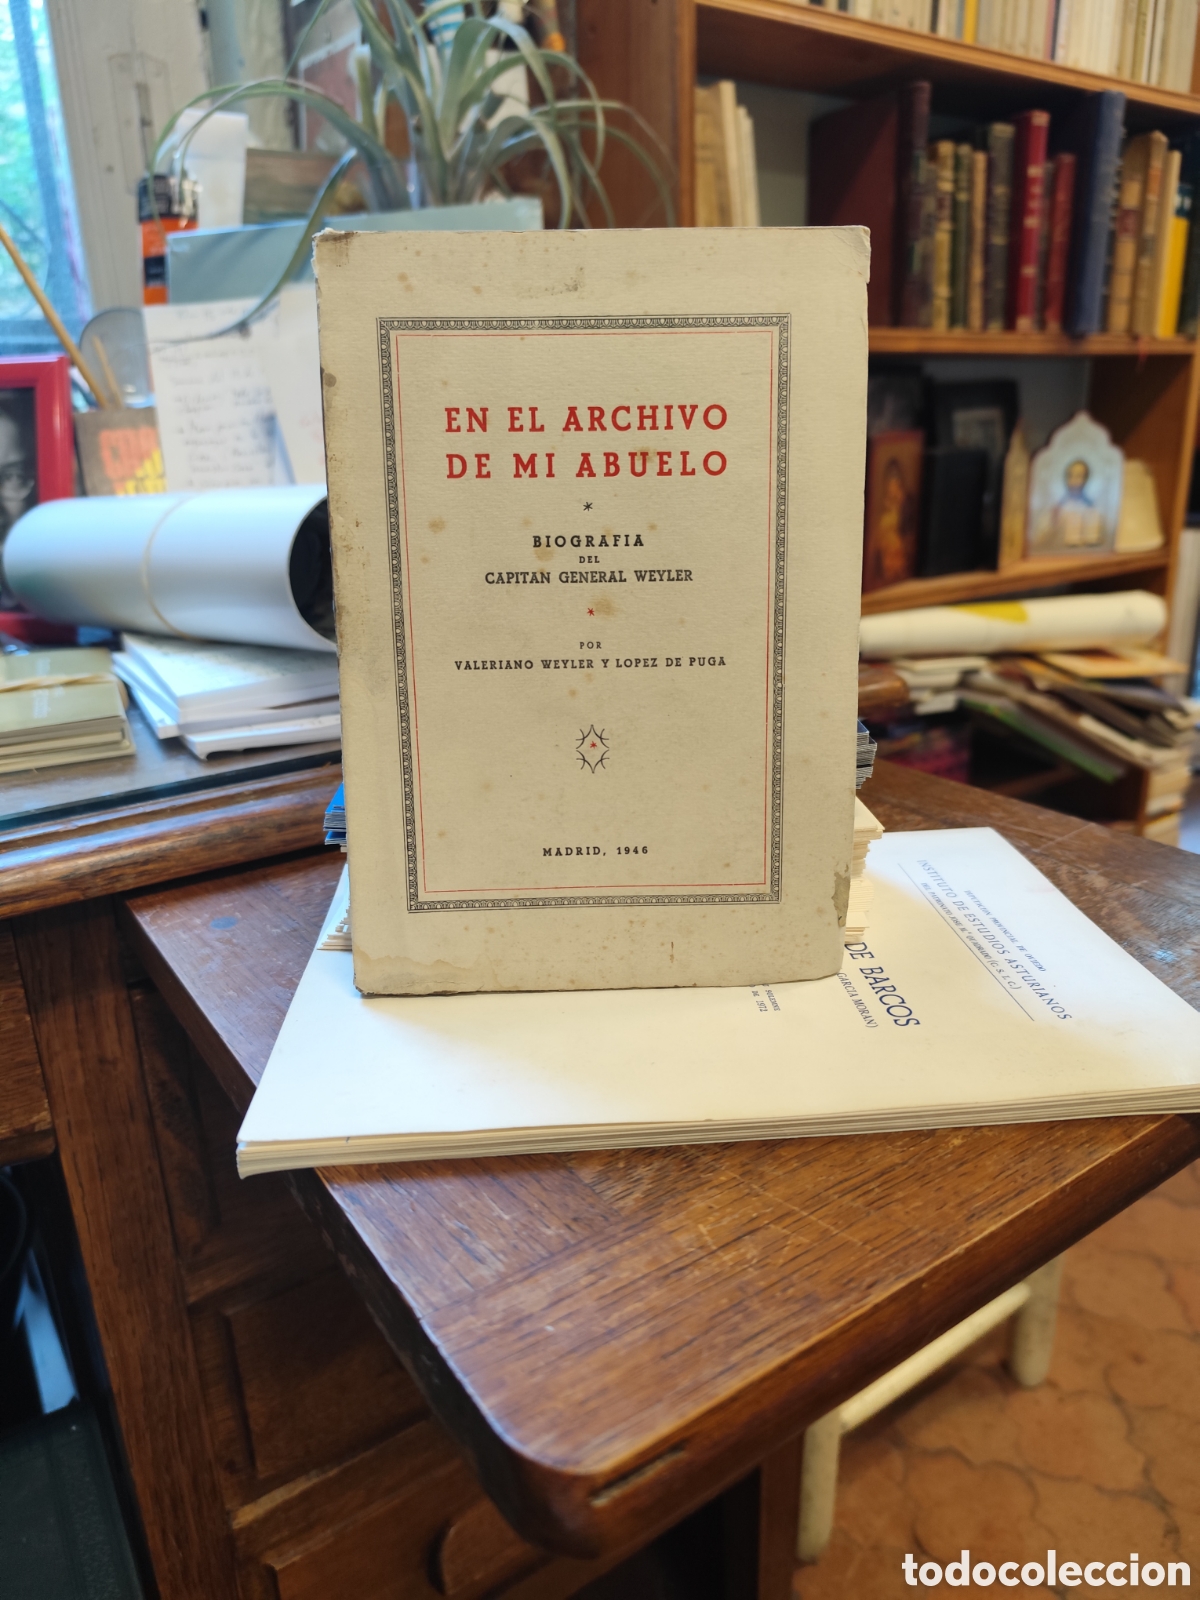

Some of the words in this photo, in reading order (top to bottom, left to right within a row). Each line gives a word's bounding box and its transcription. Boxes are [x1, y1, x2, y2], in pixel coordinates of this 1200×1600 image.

[445, 407, 489, 433] EN
[507, 406, 545, 432] EL
[562, 404, 728, 432] ARCHIVO
[446, 453, 491, 479] DE
[513, 453, 556, 478] MI
[575, 451, 728, 478] ABUELO
[532, 534, 645, 549] BIOGRAFIA
[578, 556, 601, 565] DEL
[485, 571, 551, 585] CAPITAN
[559, 571, 627, 584] GENERAL
[634, 570, 694, 583] WEYLER
[579, 642, 603, 651] POR
[455, 660, 535, 672] VALERIANO
[541, 660, 595, 670] WEYLER
[602, 659, 610, 669] Y
[616, 659, 659, 669] LOPEZ
[666, 658, 682, 668] DE
[689, 657, 727, 668] PUGA
[542, 846, 607, 857] MADRID,
[616, 845, 649, 855] 1946
[917, 859, 958, 898] INSTITUTO
[951, 900, 970, 911] DE
[963, 913, 1010, 955] ESTUDIOS
[1004, 958, 1073, 1020] ASTURIANOS
[844, 941, 875, 960] DE
[1024, 953, 1047, 972] OVIEDO
[836, 972, 859, 998] GARCIA
[851, 998, 879, 1028] MORAN)
[859, 966, 921, 1027] BARCOS
